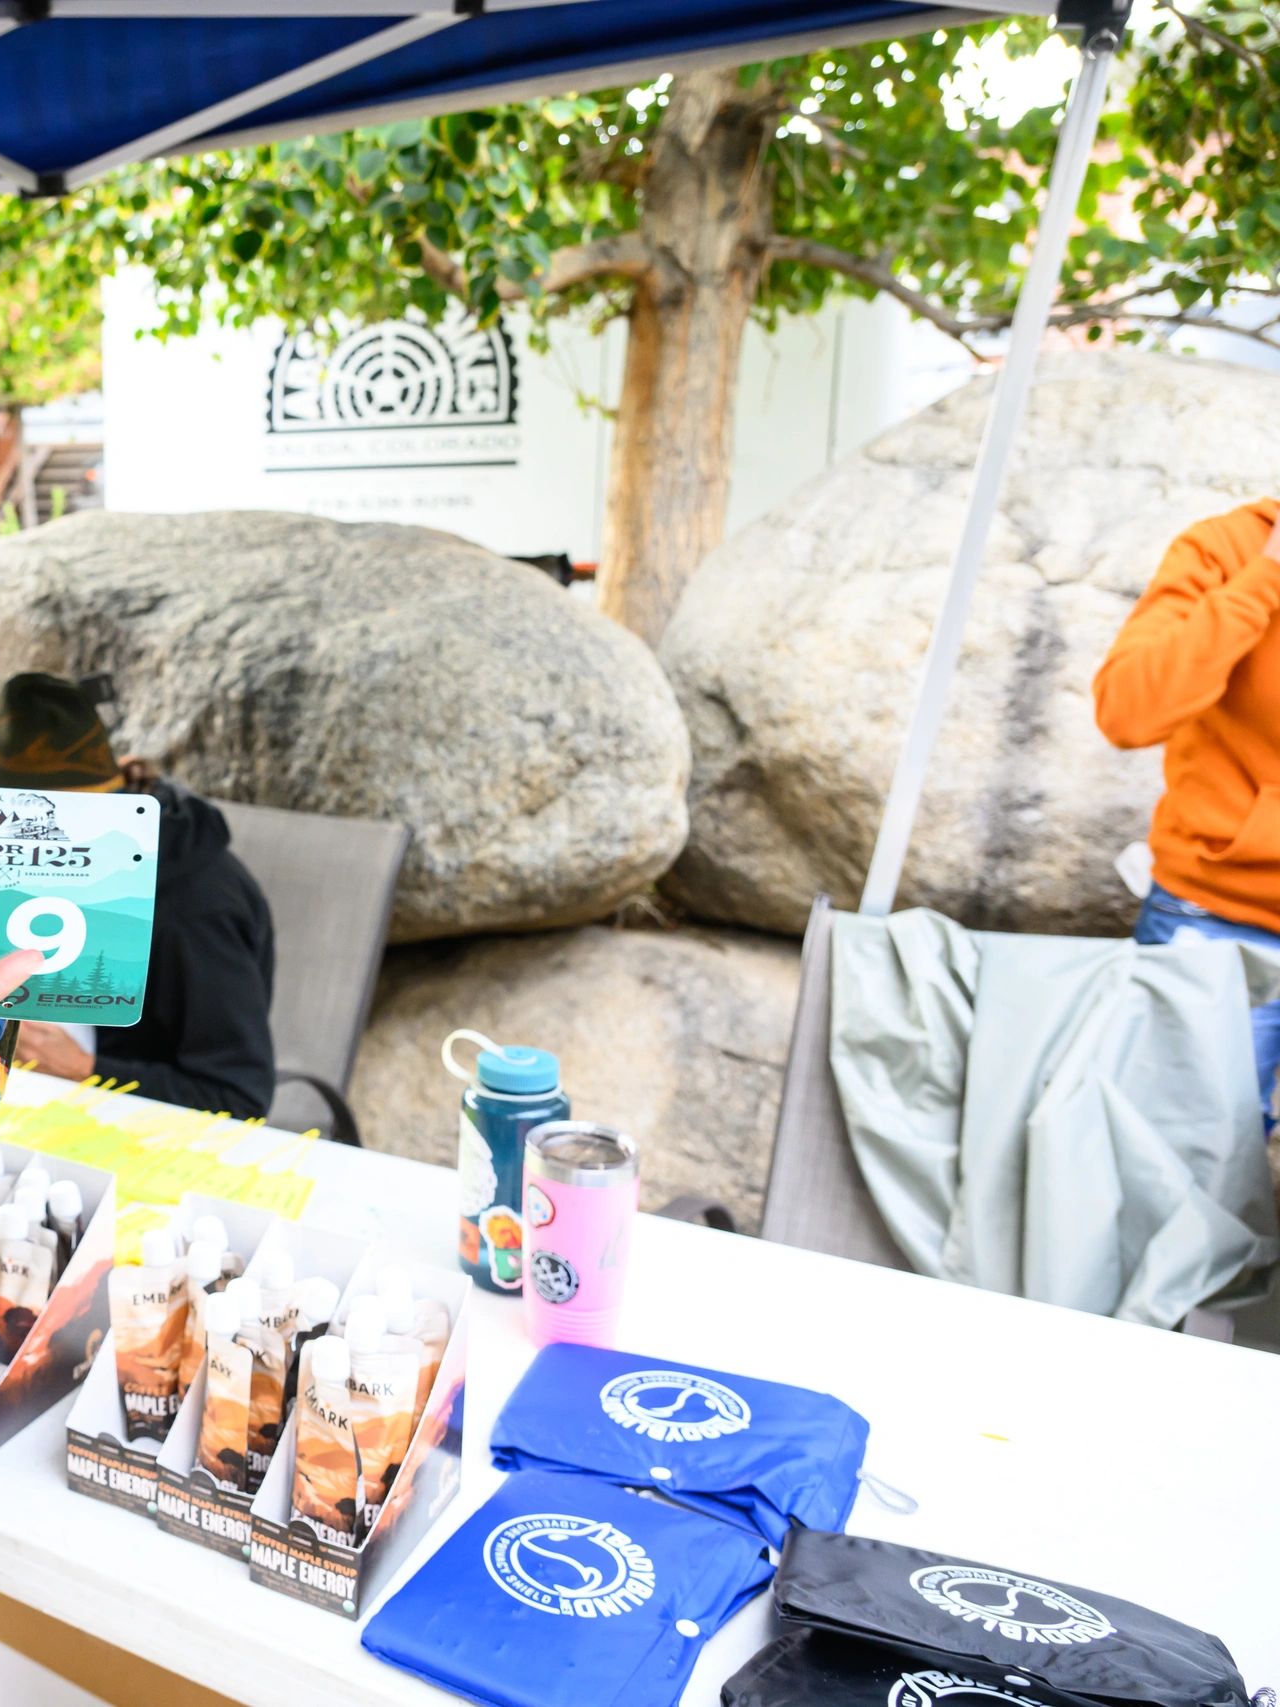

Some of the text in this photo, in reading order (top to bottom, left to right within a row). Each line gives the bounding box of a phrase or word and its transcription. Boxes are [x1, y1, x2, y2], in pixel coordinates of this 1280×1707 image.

[29, 845, 92, 868] 125
[37, 993, 136, 1006] ERGON
[124, 1392, 168, 1417] MAPLE
[67, 1453, 108, 1486] MAPLE
[108, 1467, 158, 1501] ENERGY
[157, 1490, 200, 1527] MAPLE
[200, 1508, 252, 1544] ENERGY
[503, 1519, 579, 1540] ADVENTURE
[250, 1540, 297, 1579] MAPLE
[299, 1560, 357, 1600] ENERGY
[251, 1531, 289, 1554] COFFEE
[288, 1548, 323, 1568] MAPLE
[322, 1559, 358, 1578] SYRUP
[505, 1574, 552, 1605] SHIELD
